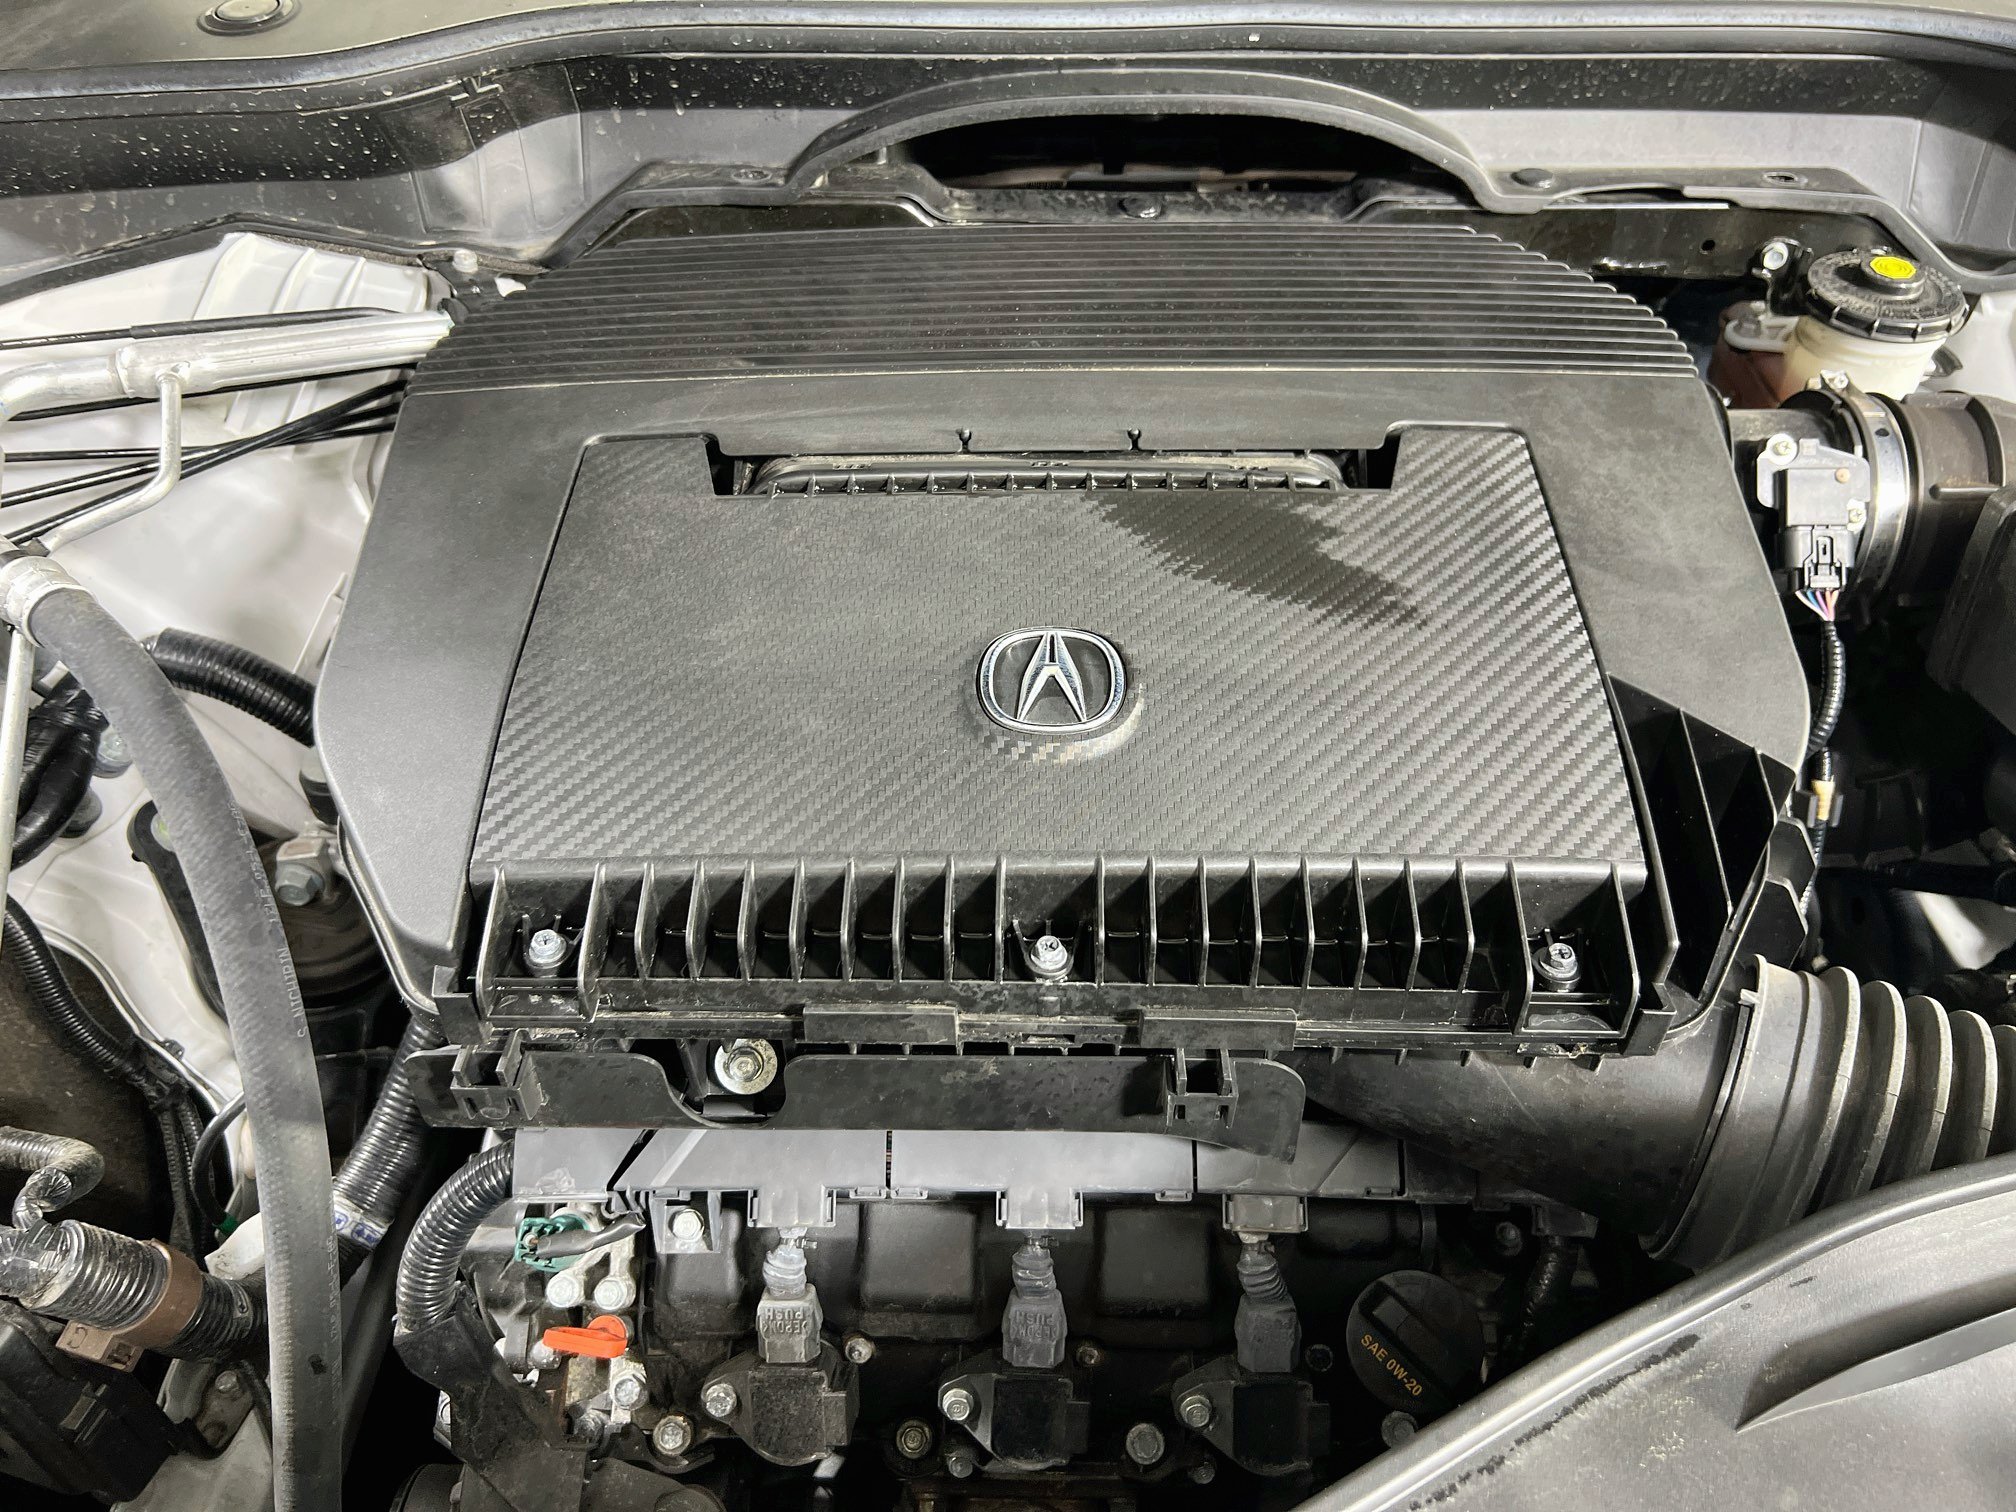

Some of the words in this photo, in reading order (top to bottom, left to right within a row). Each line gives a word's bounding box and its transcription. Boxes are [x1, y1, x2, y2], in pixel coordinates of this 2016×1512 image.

[765, 1306, 804, 1320] PUSH
[1016, 1310, 1058, 1325] PUSH
[1361, 1334, 1388, 1361] SAE
[1387, 1359, 1422, 1396] 0W-20
